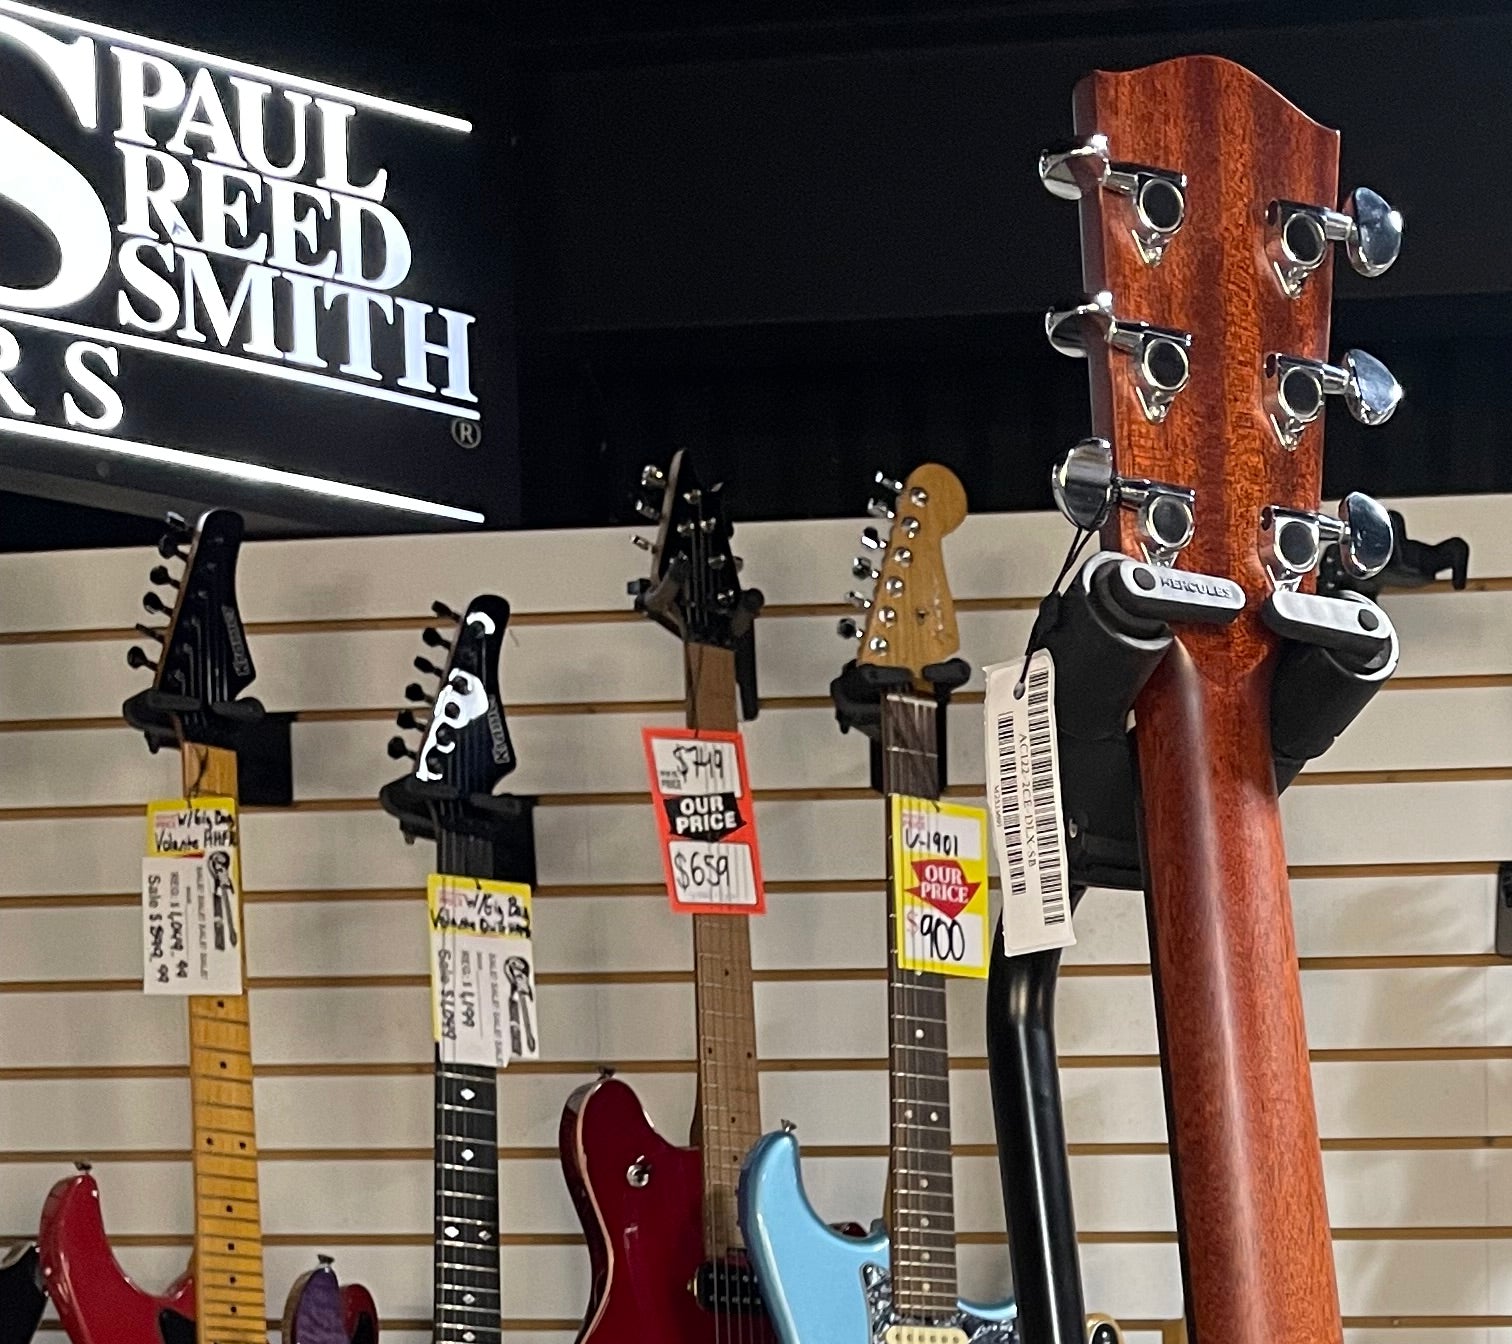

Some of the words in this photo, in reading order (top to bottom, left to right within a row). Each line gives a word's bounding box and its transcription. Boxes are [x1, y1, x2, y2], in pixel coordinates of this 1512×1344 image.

[111, 45, 388, 202] PAUL
[117, 140, 412, 293] REED
[117, 235, 480, 403] SMITH
[1160, 576, 1232, 599] HERCULES
[679, 795, 724, 816] OUR
[675, 811, 737, 834] PRICE
[674, 851, 730, 892] $659
[925, 865, 962, 885] OUR
[921, 883, 968, 903] PRICE
